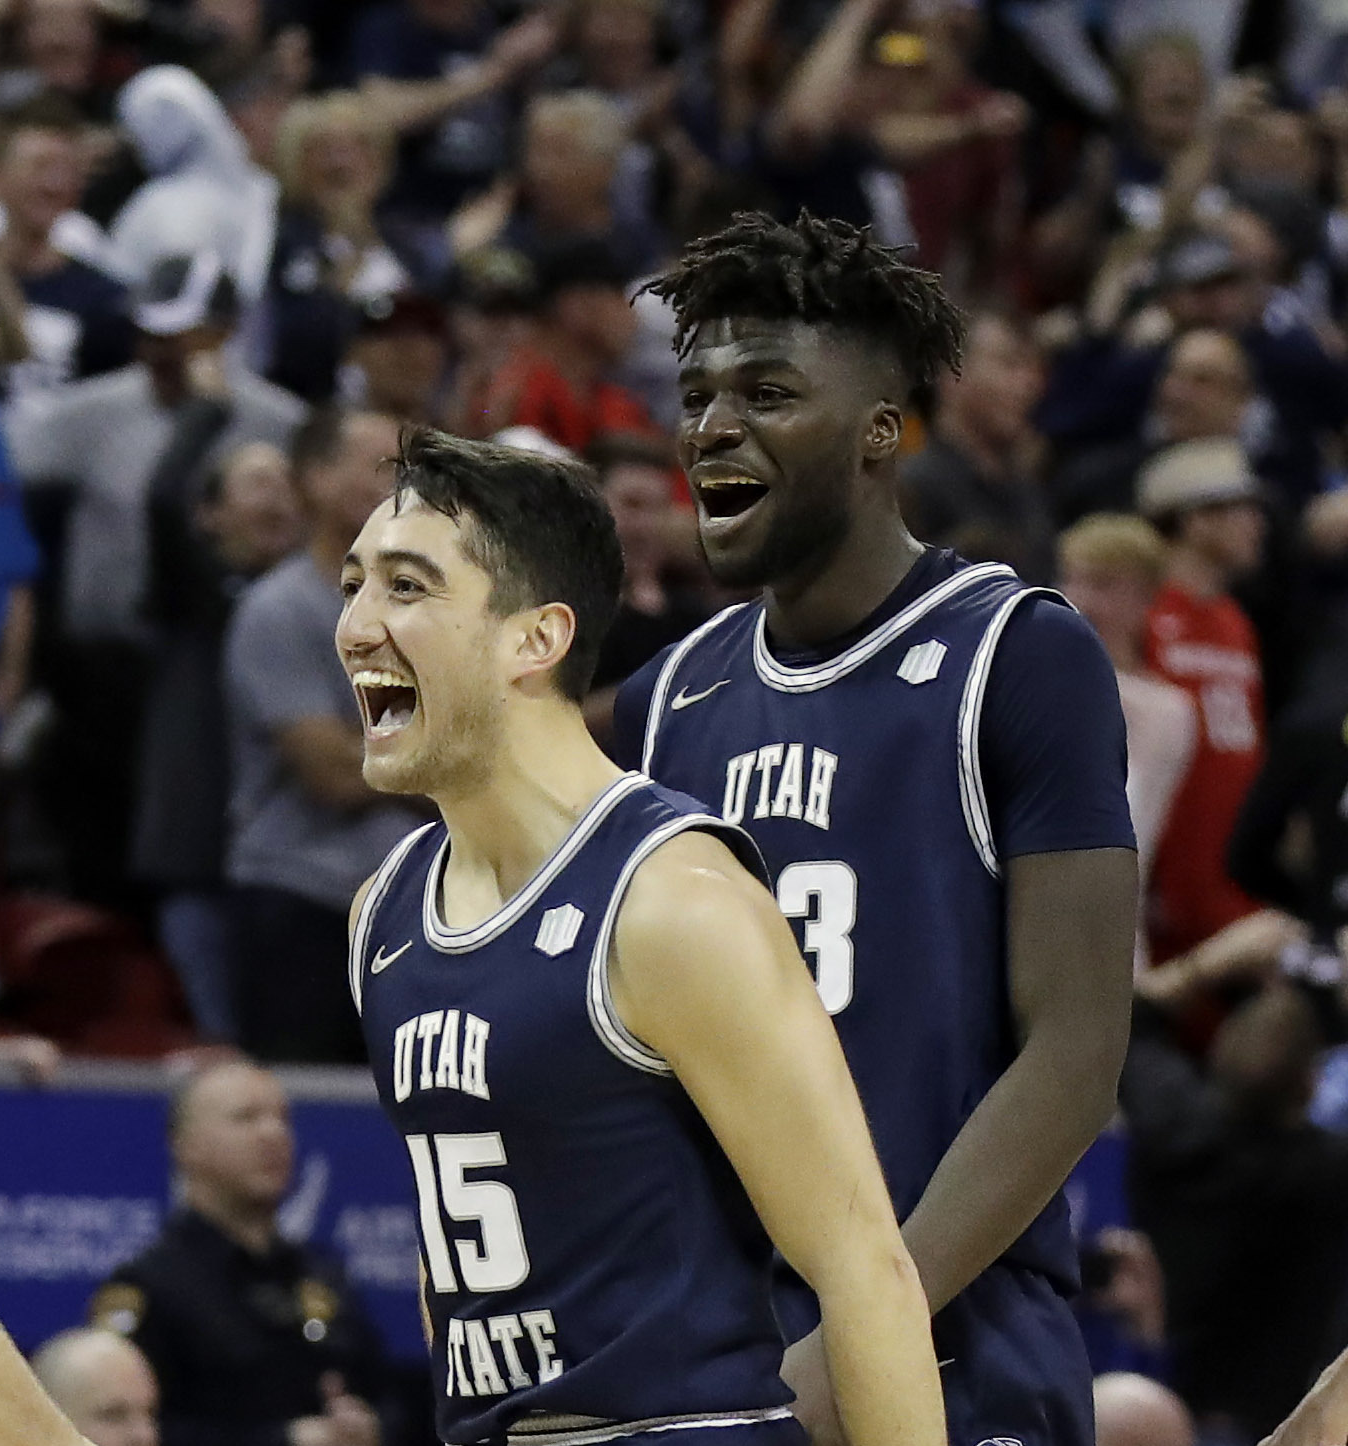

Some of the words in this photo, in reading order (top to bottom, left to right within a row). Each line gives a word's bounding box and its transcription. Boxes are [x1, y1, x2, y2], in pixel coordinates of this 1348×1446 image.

[723, 743, 839, 830] UTAH
[393, 1009, 490, 1103] UTAH
[406, 1132, 530, 1294] 15
[447, 1308, 563, 1398] TATE
